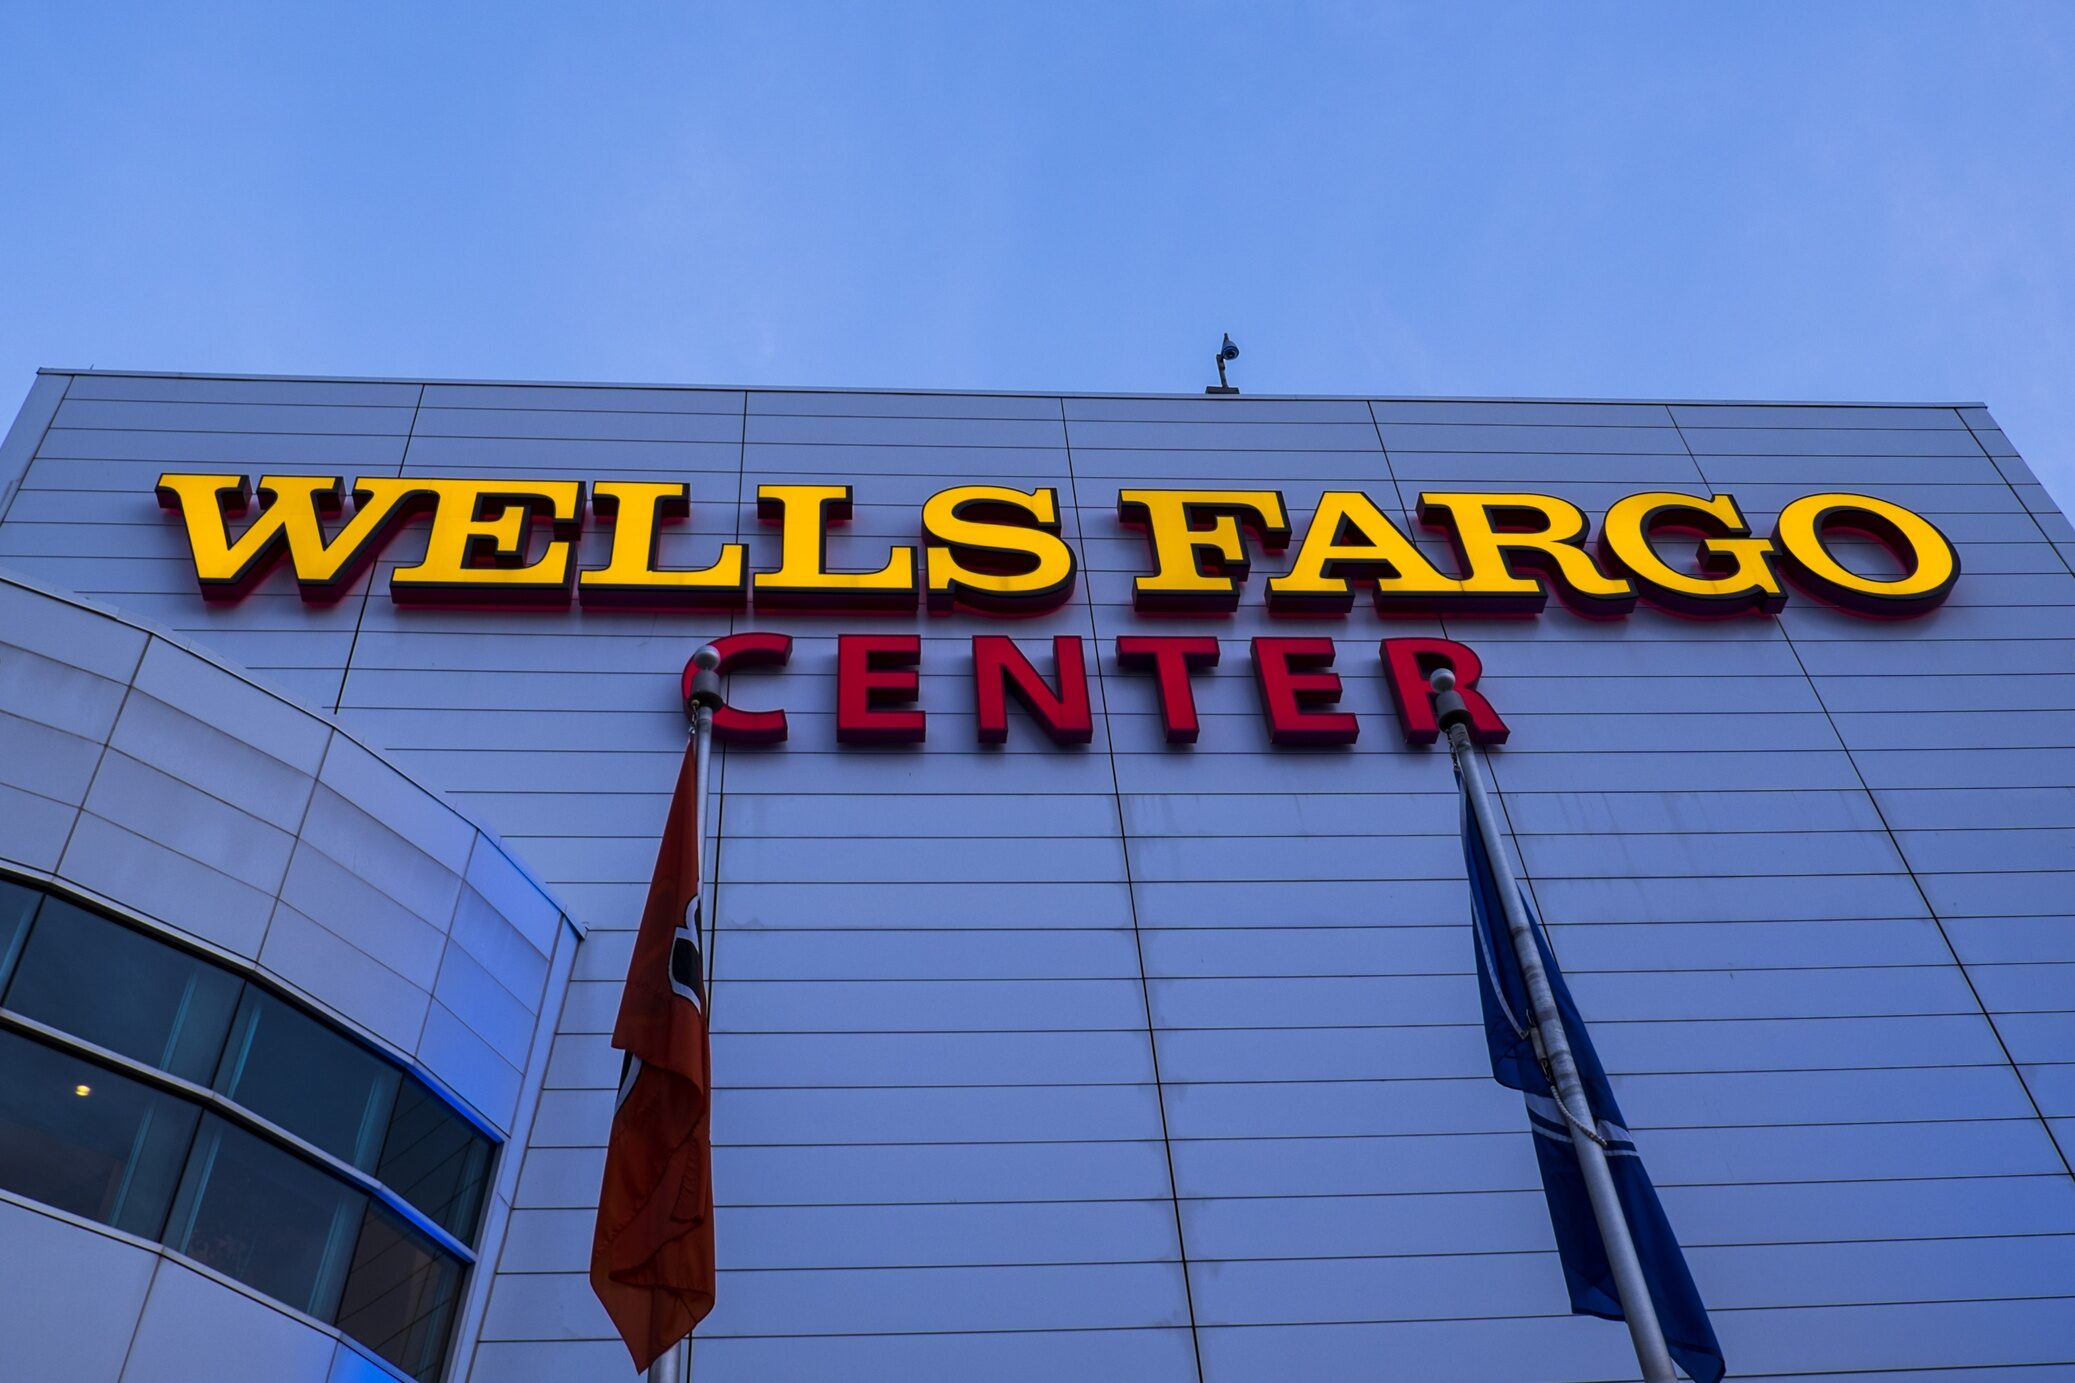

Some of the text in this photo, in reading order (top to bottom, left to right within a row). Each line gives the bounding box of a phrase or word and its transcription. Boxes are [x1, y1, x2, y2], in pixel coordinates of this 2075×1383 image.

[157, 472, 1957, 612] WELLS FARGO
[681, 632, 1509, 746] CENTER
